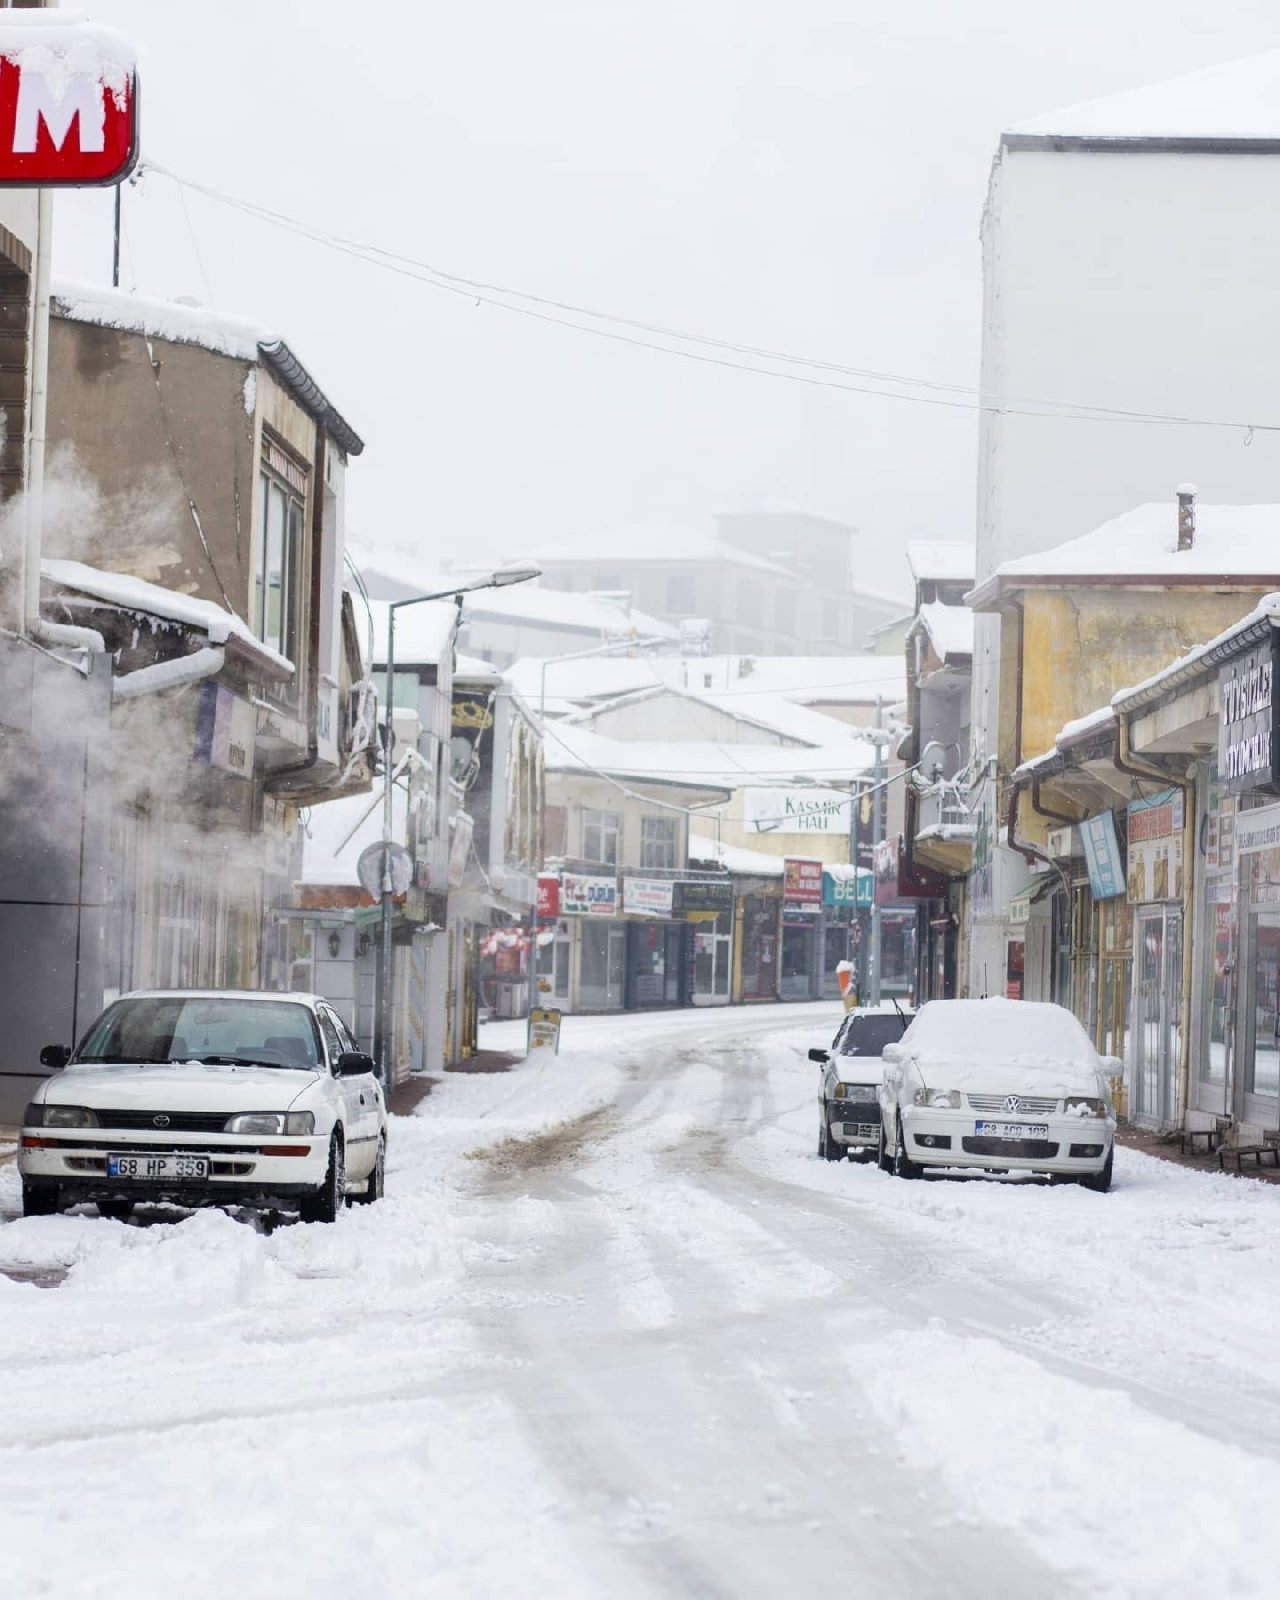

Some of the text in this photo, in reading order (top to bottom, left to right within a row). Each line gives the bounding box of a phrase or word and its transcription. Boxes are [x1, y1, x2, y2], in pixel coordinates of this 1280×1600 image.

[119, 1159, 205, 1176] 68 HP 359
